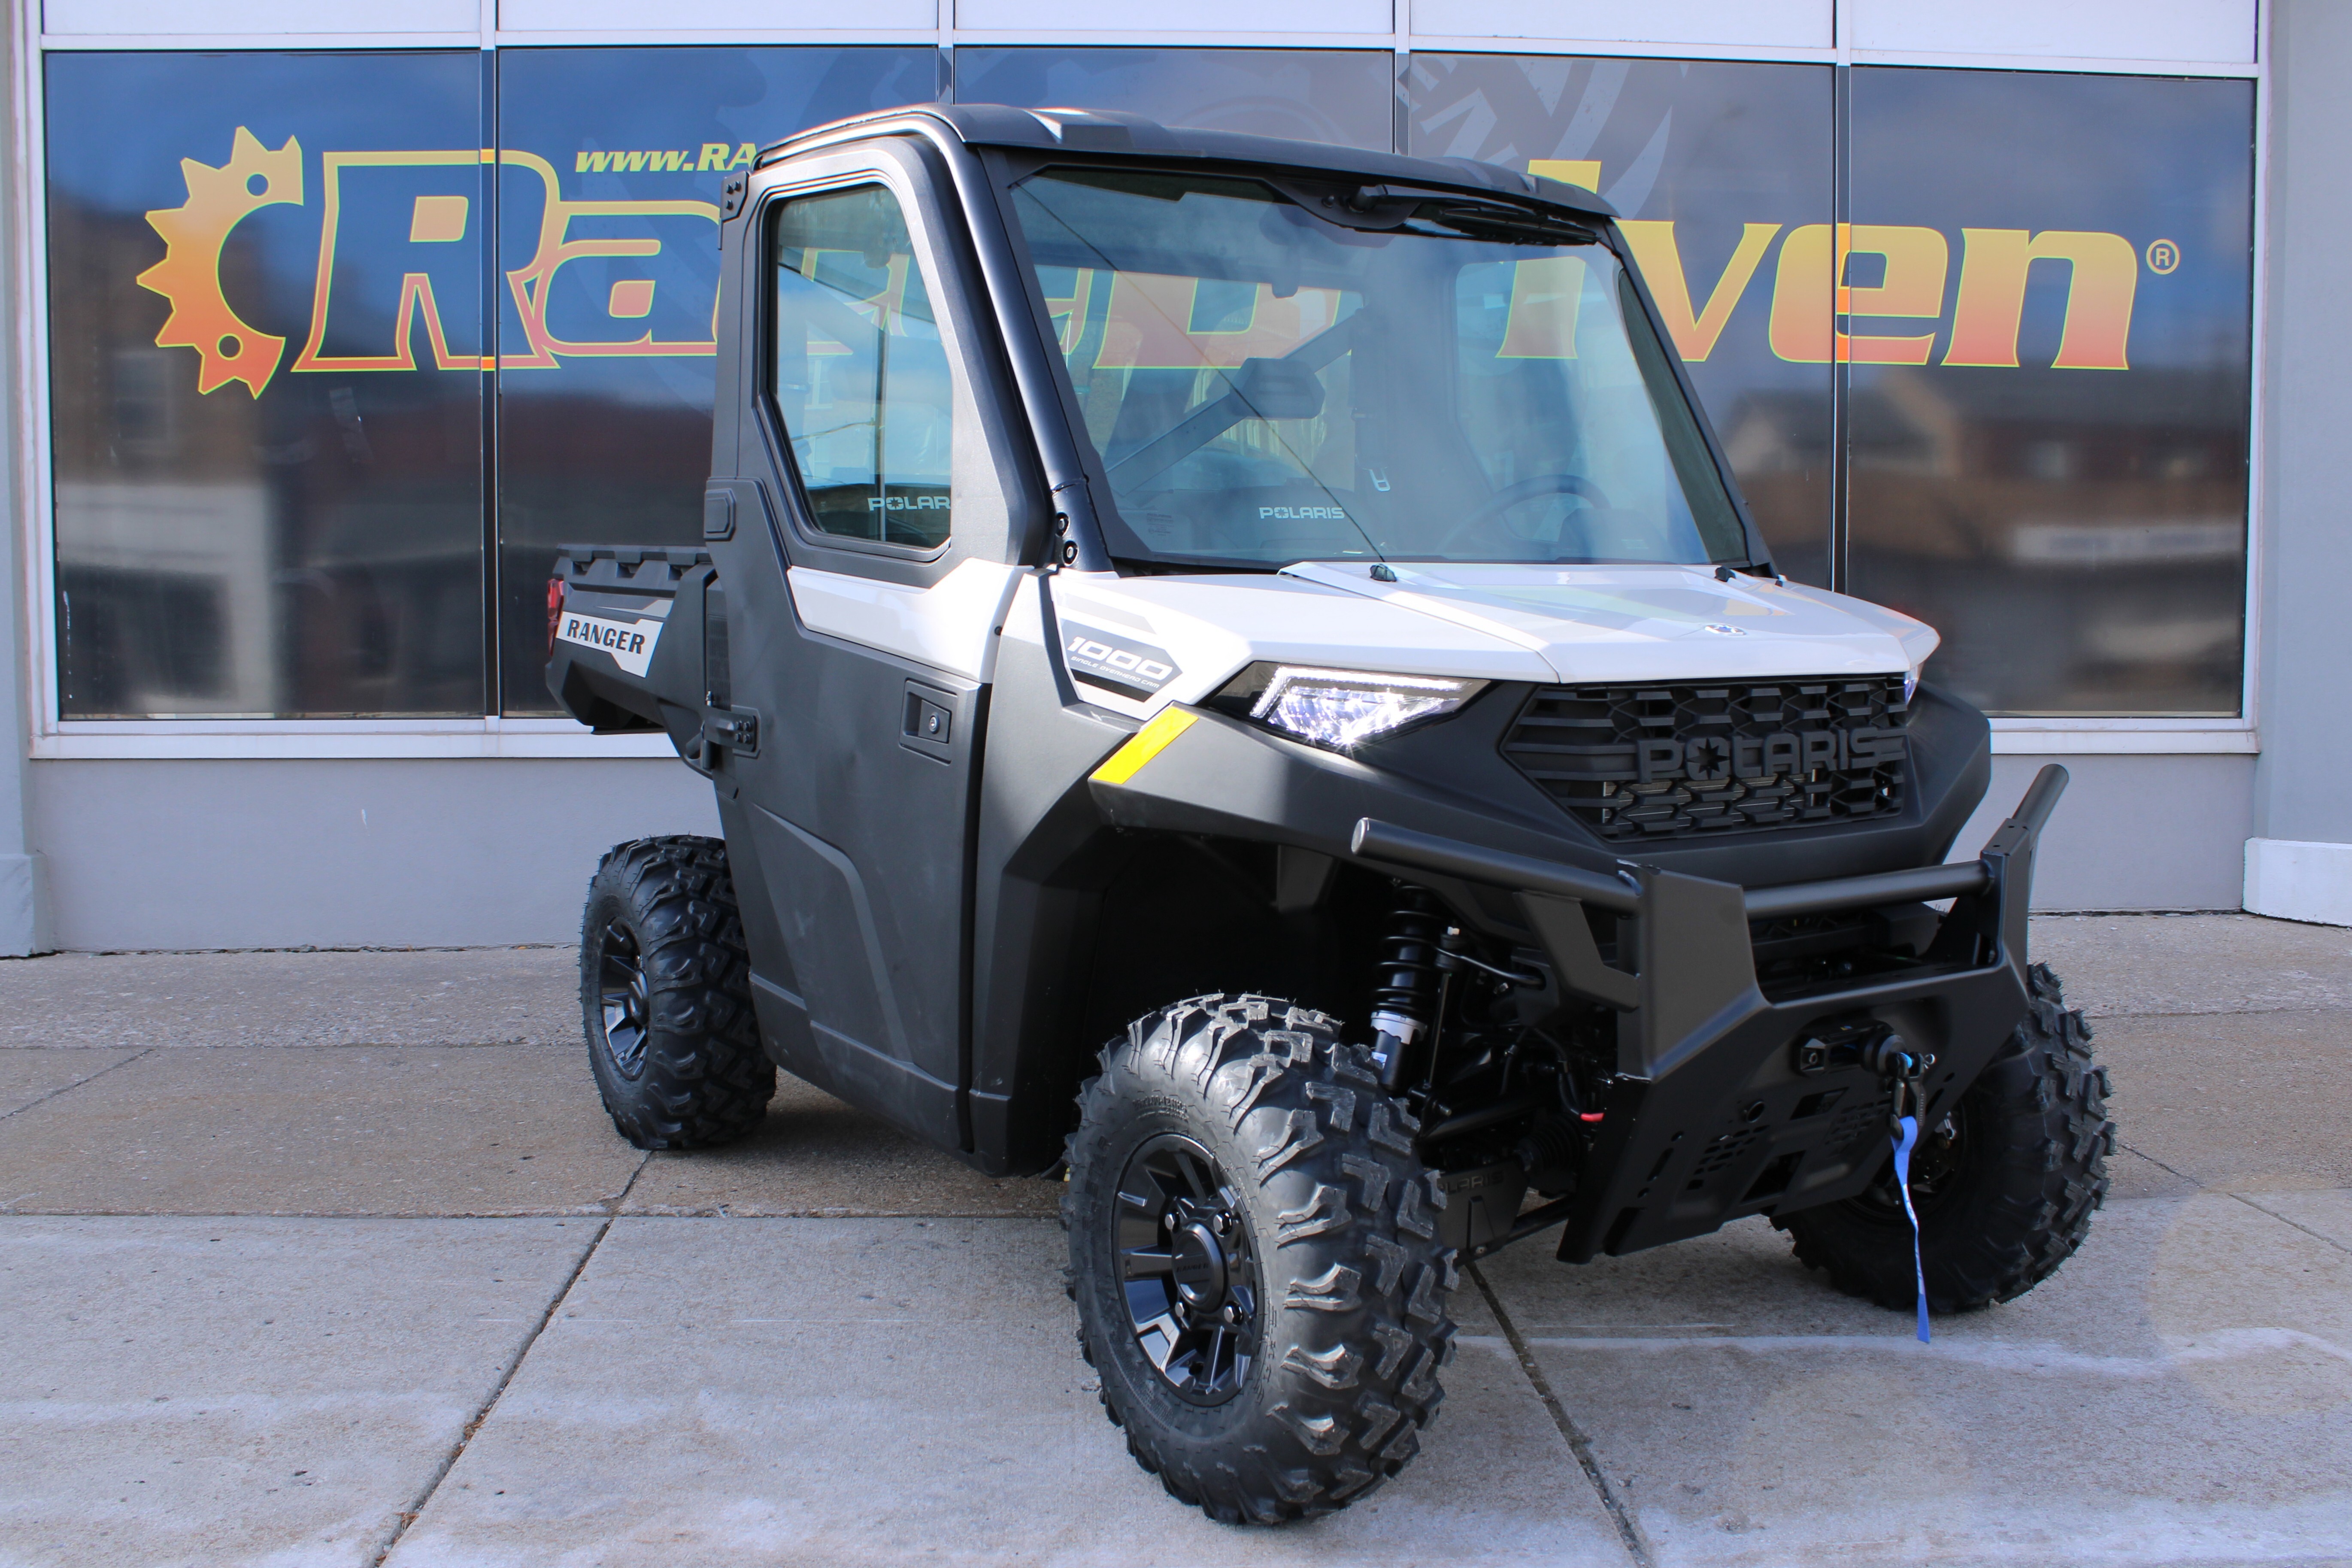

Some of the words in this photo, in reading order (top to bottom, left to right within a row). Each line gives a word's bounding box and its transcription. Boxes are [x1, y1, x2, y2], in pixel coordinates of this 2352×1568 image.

[1259, 507, 1345, 519] POLARIS
[567, 619, 645, 655] RANGER
[1067, 637, 1173, 681] 1000
[1071, 656, 1099, 668] SINGLE
[1100, 665, 1141, 682] OVERHEAD
[1141, 679, 1160, 688] CAM
[1637, 726, 1882, 783] POLARIS
